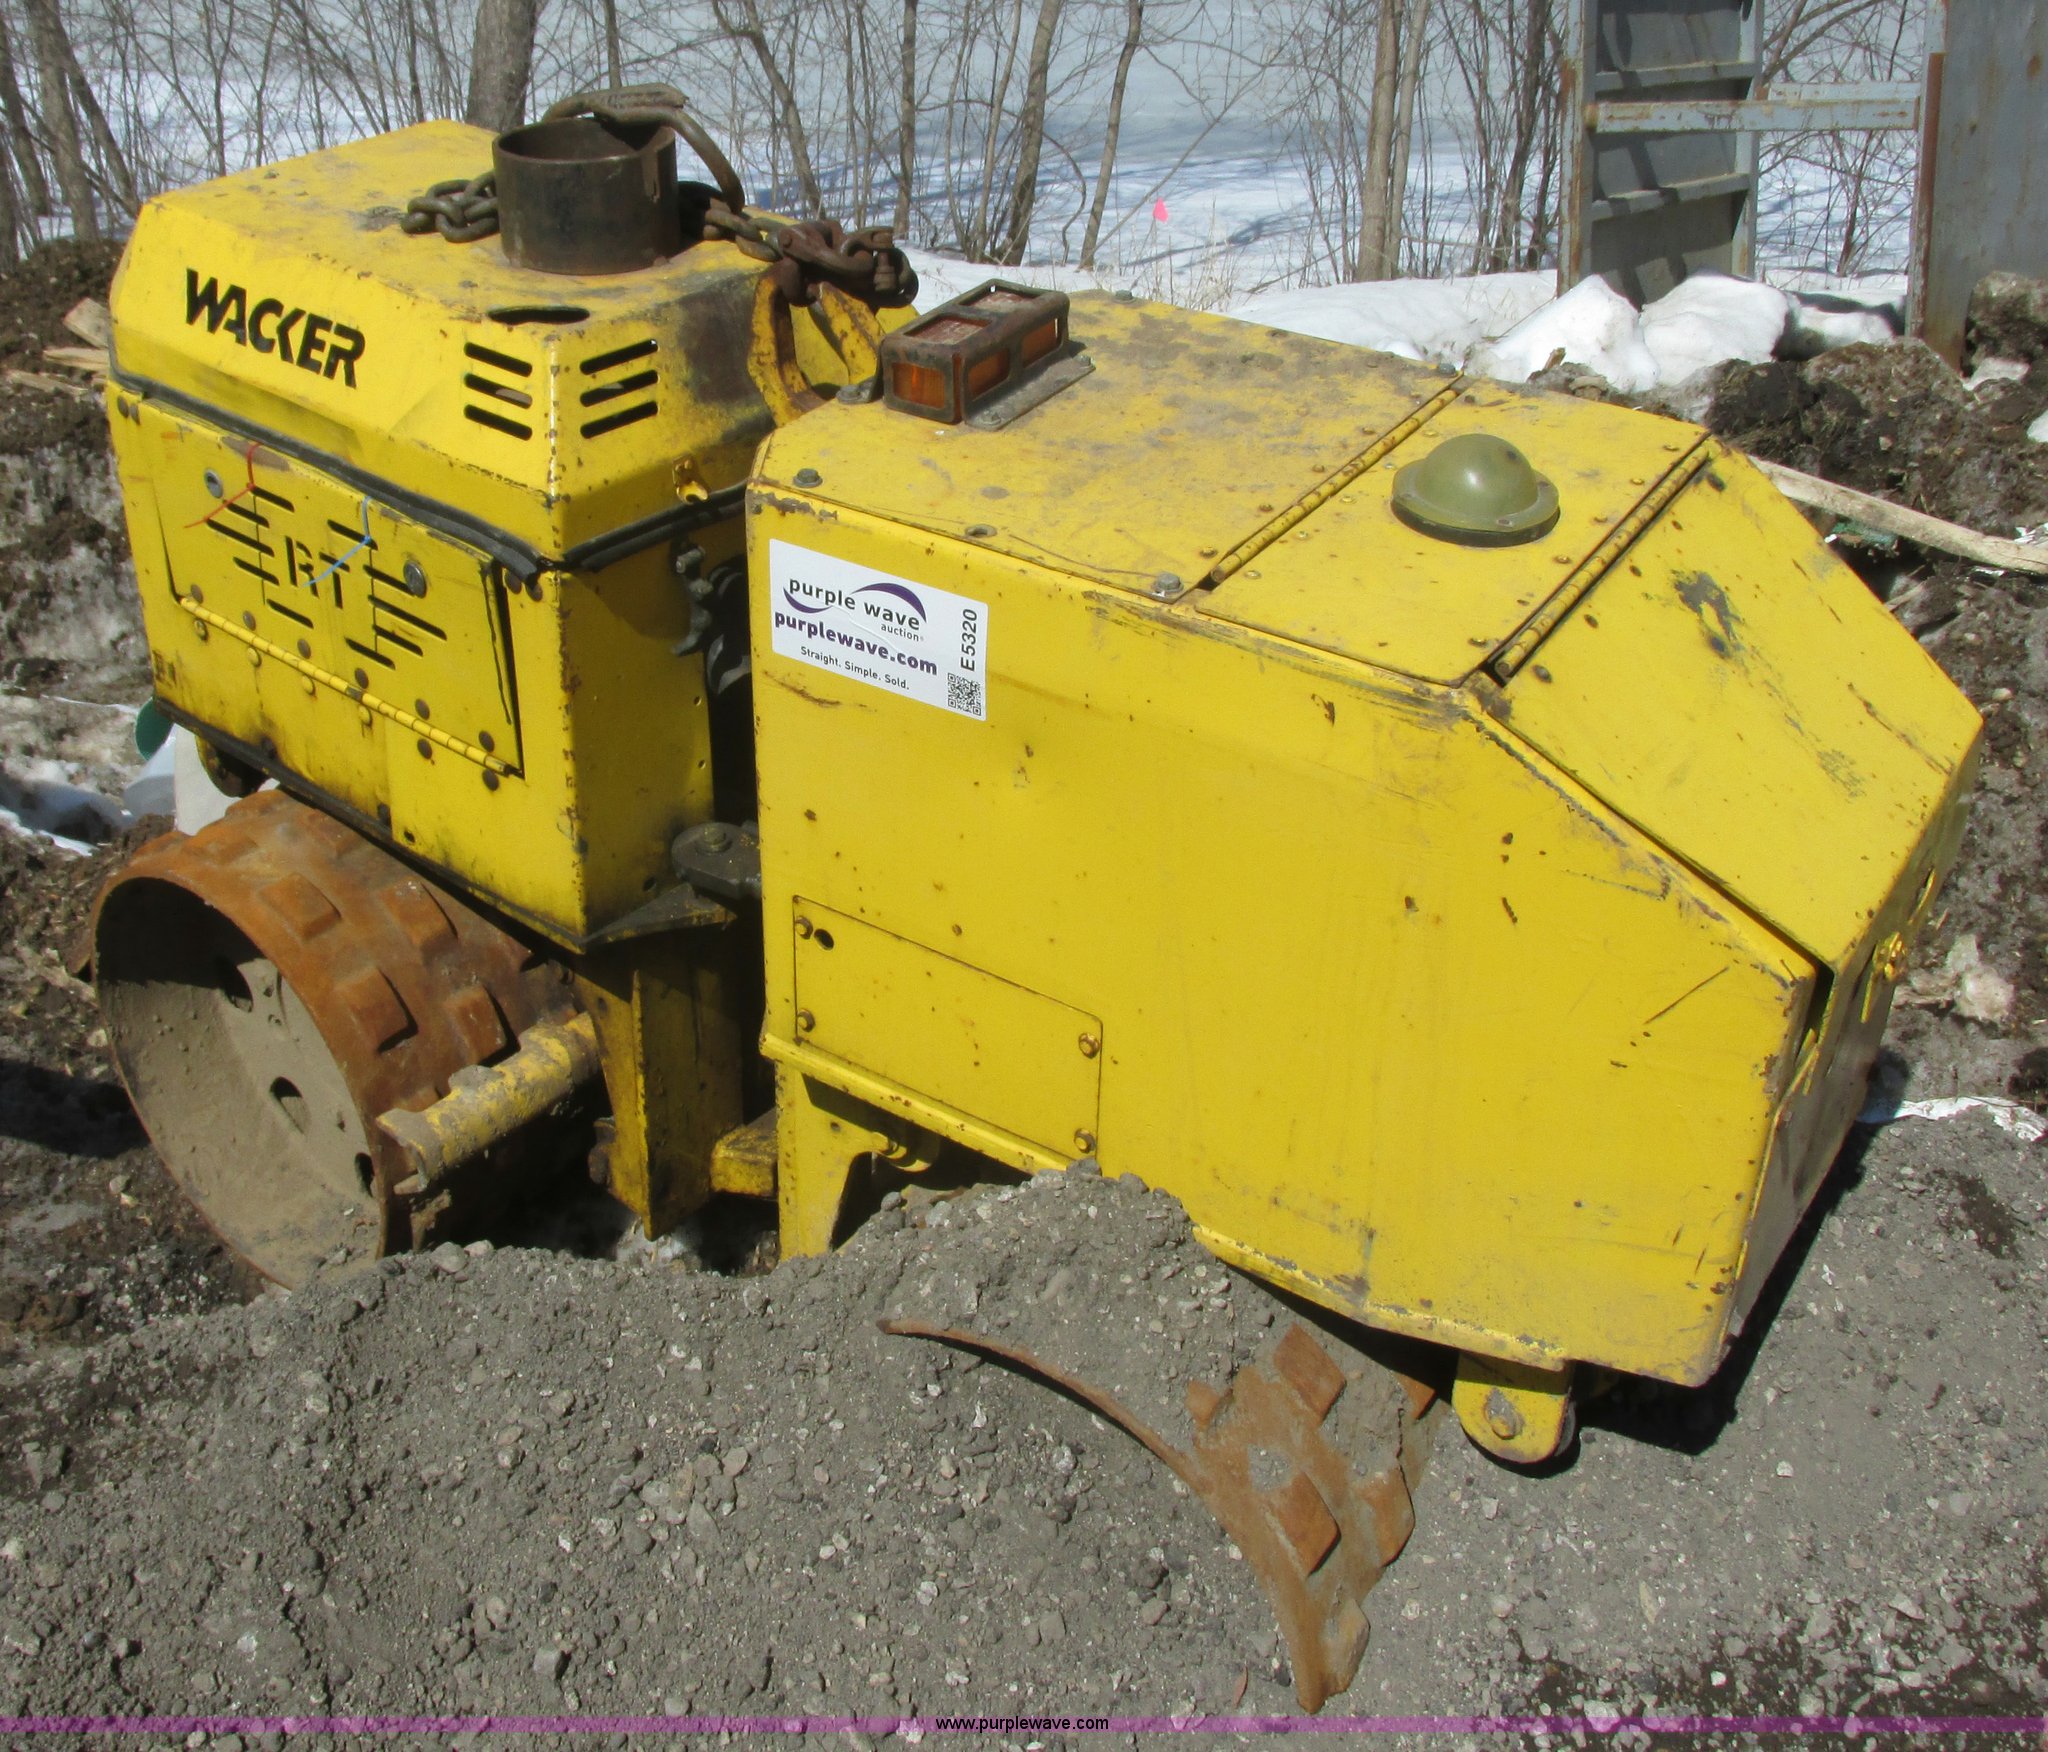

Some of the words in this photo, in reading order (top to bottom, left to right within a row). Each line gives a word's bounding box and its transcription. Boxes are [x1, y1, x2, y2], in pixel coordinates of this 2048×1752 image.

[185, 267, 366, 389] WACKER
[789, 578, 856, 610] purple
[863, 601, 920, 631] wave
[774, 611, 938, 676] purplewave.com
[800, 646, 842, 668] Straight.
[844, 661, 882, 681] Simple.
[884, 673, 910, 690] Sold.
